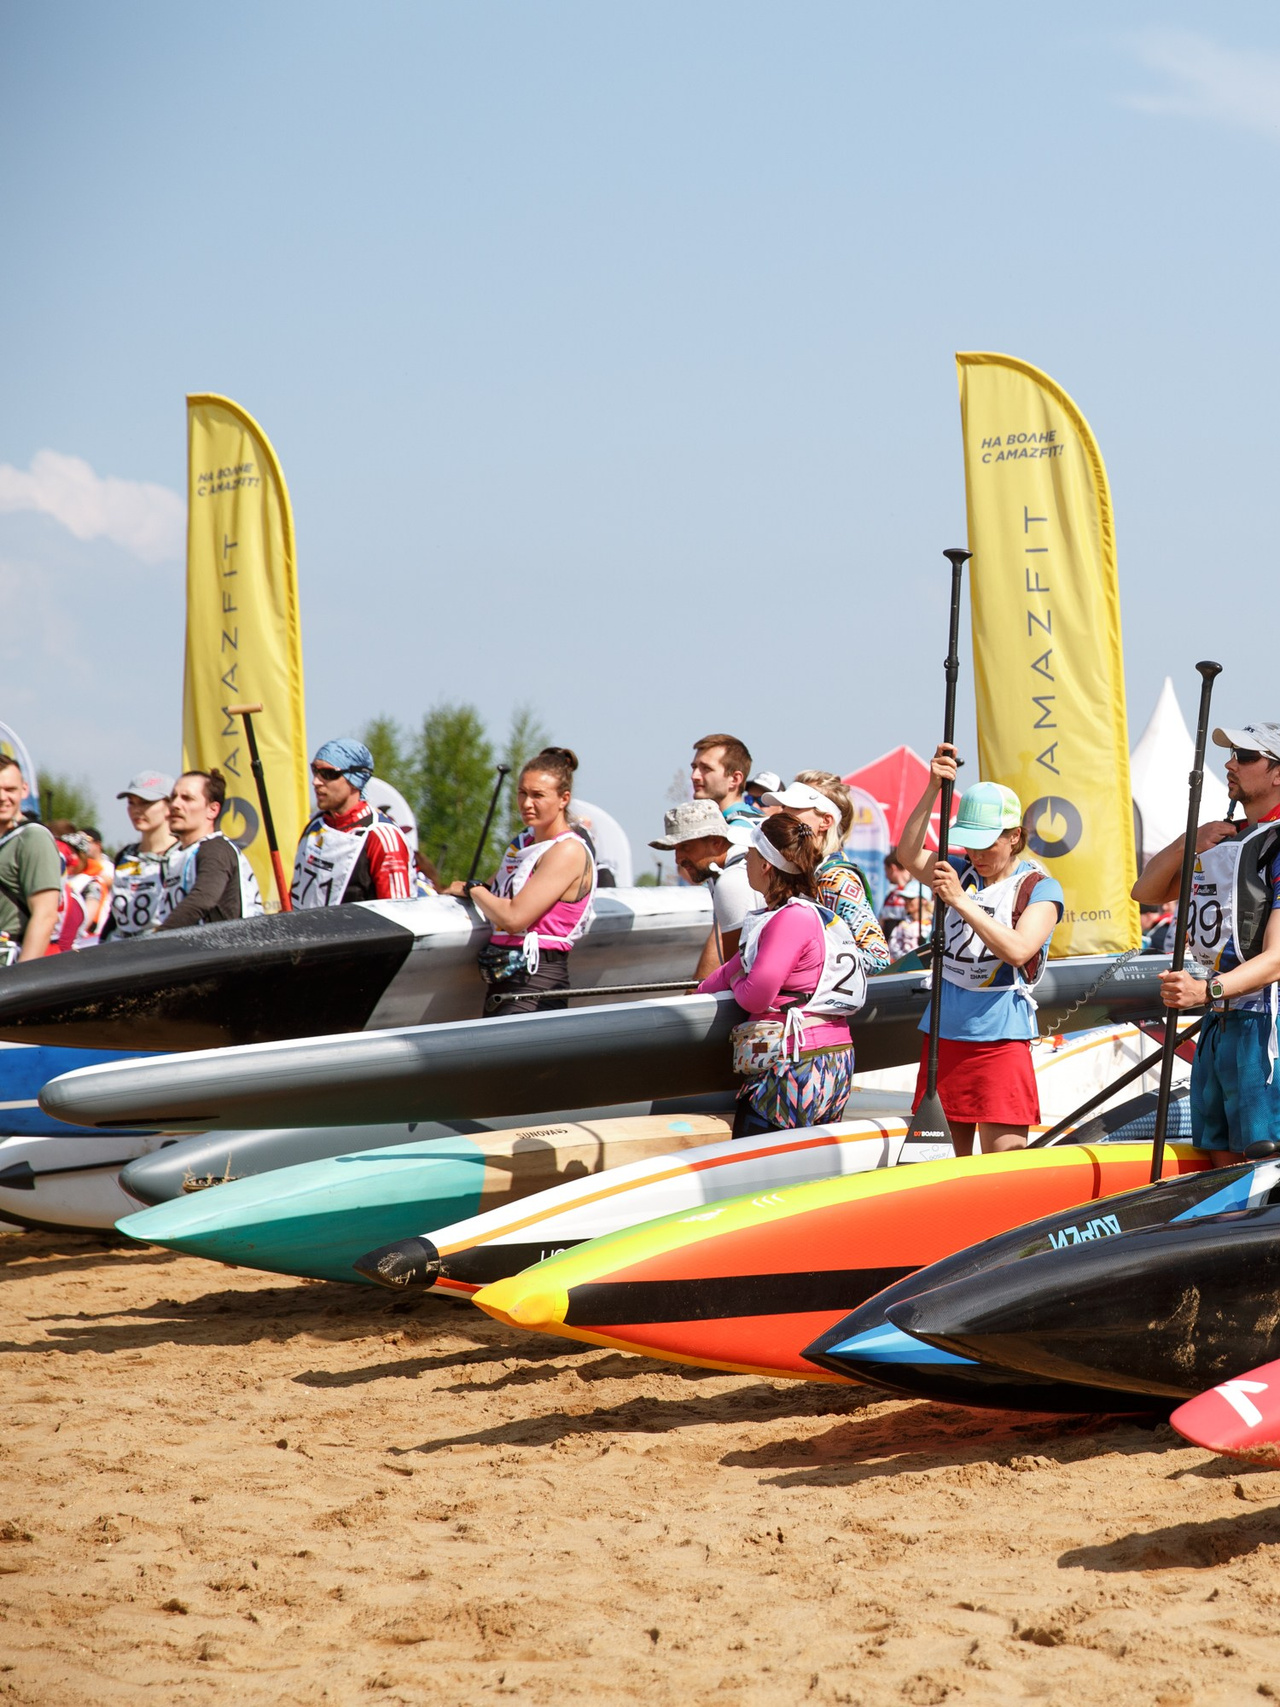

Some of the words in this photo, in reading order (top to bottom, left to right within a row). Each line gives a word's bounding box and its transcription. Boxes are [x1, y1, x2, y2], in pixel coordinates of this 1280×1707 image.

[981, 435, 1002, 449] НА
[1006, 430, 1057, 446] ВОЛНЕ
[995, 444, 1064, 463] AMAZFIT!
[1024, 505, 1061, 776] AMAZFIT
[221, 534, 241, 778] AMAZFIT
[112, 894, 150, 926] 98
[516, 1129, 557, 1139] SUNOVA
